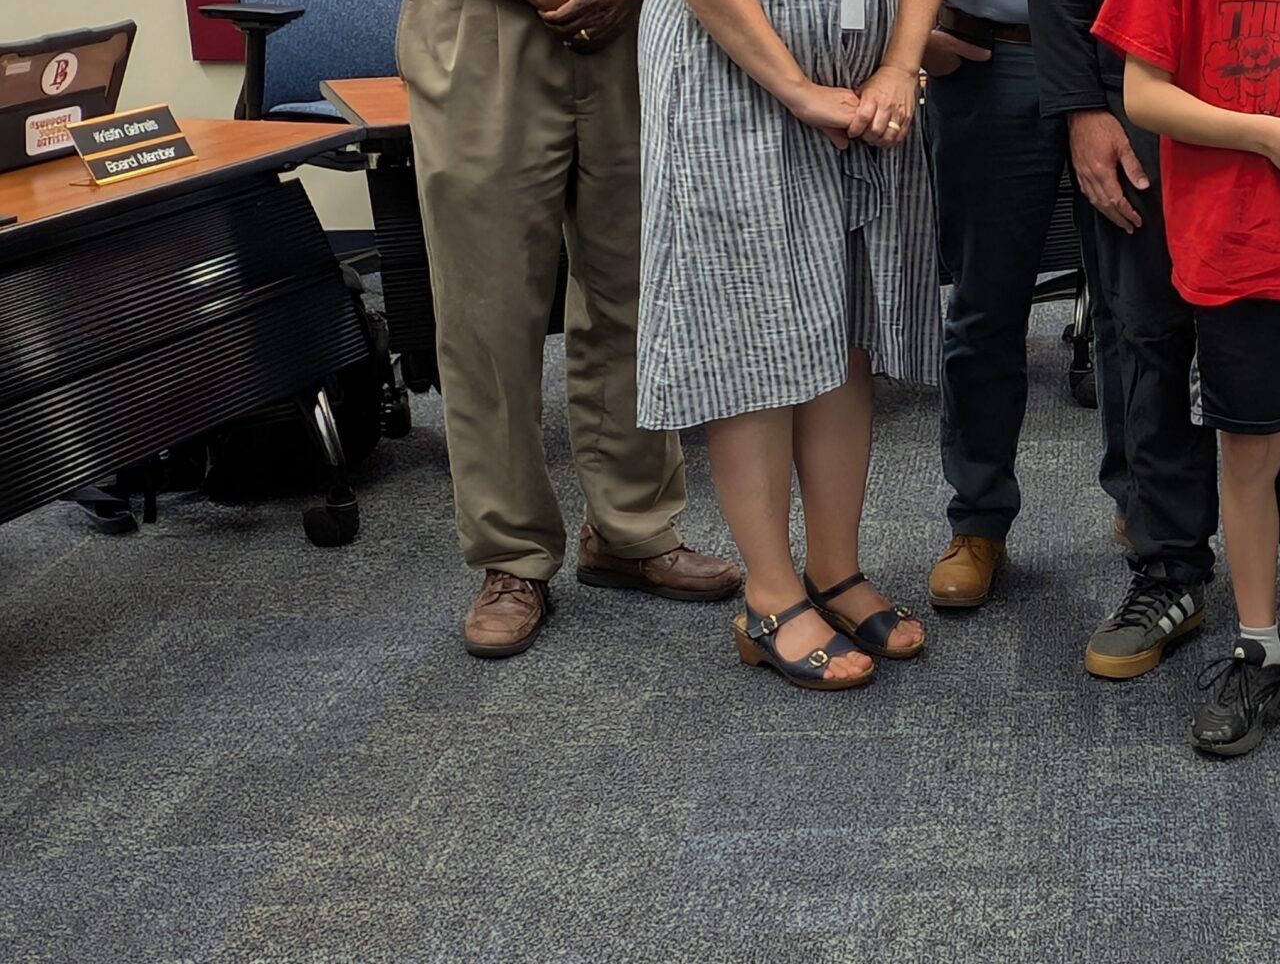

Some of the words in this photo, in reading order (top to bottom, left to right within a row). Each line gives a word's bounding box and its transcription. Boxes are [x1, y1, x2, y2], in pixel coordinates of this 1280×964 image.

[93, 127, 125, 144] Kristin
[105, 155, 139, 173] Board
[137, 146, 175, 165] Member
